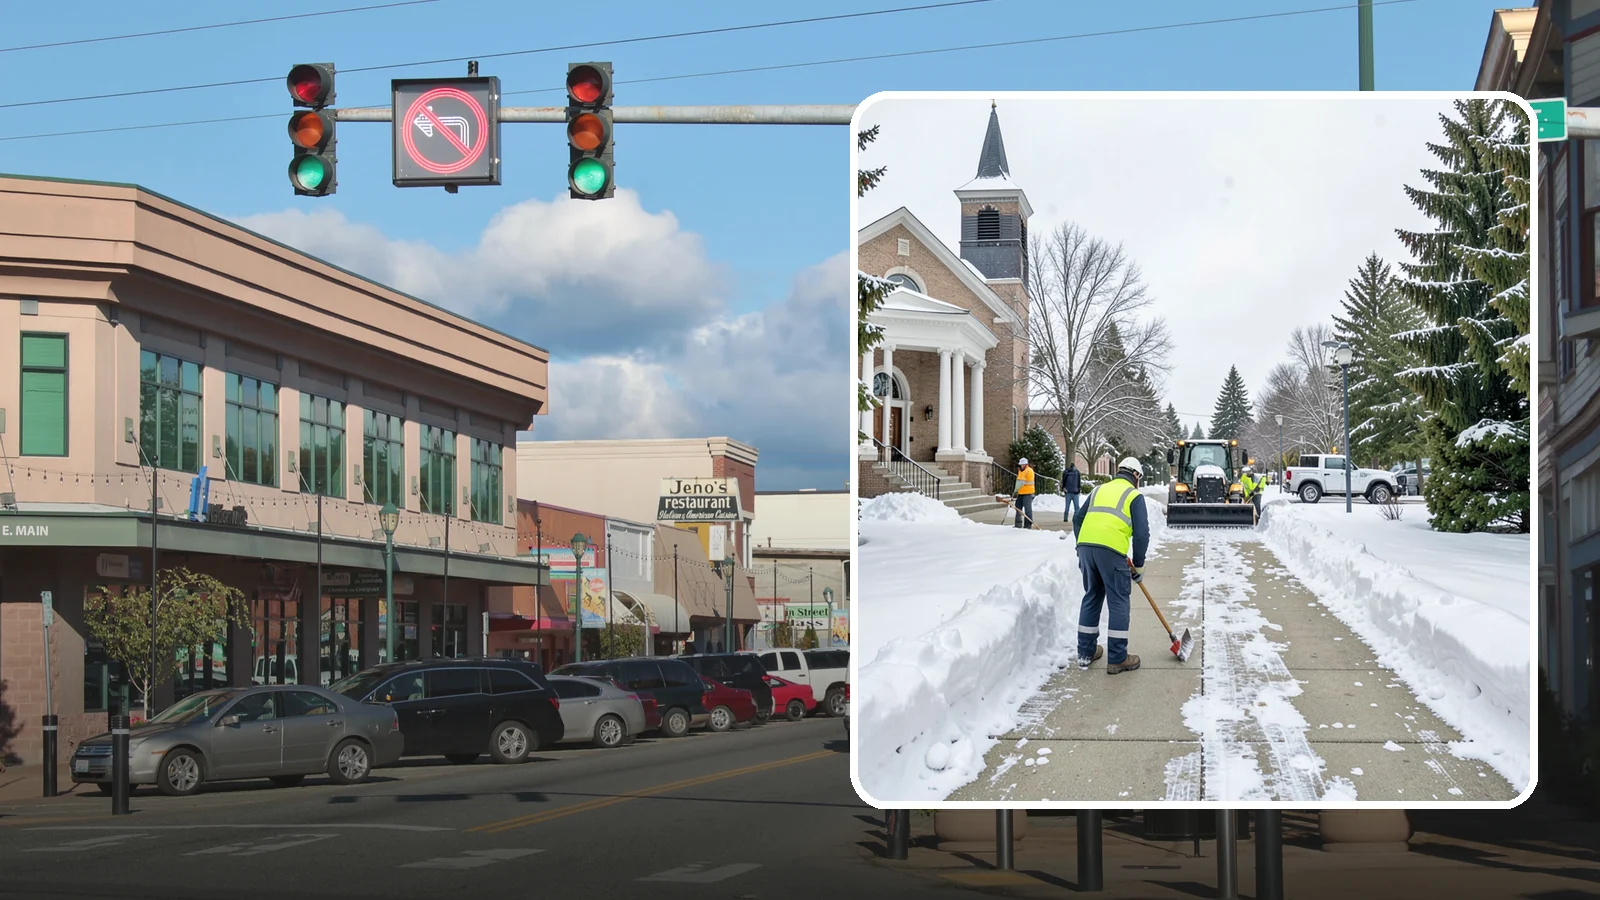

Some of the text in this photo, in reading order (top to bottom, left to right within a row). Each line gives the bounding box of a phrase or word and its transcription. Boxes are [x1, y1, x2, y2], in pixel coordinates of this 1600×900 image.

[670, 480, 727, 494] Jeno's
[665, 496, 731, 509] restaurant
[658, 509, 682, 520] Italian
[686, 509, 714, 519] American
[715, 509, 737, 519] Cuisine
[2, 525, 49, 536] E. MAIN
[797, 607, 828, 616] Street
